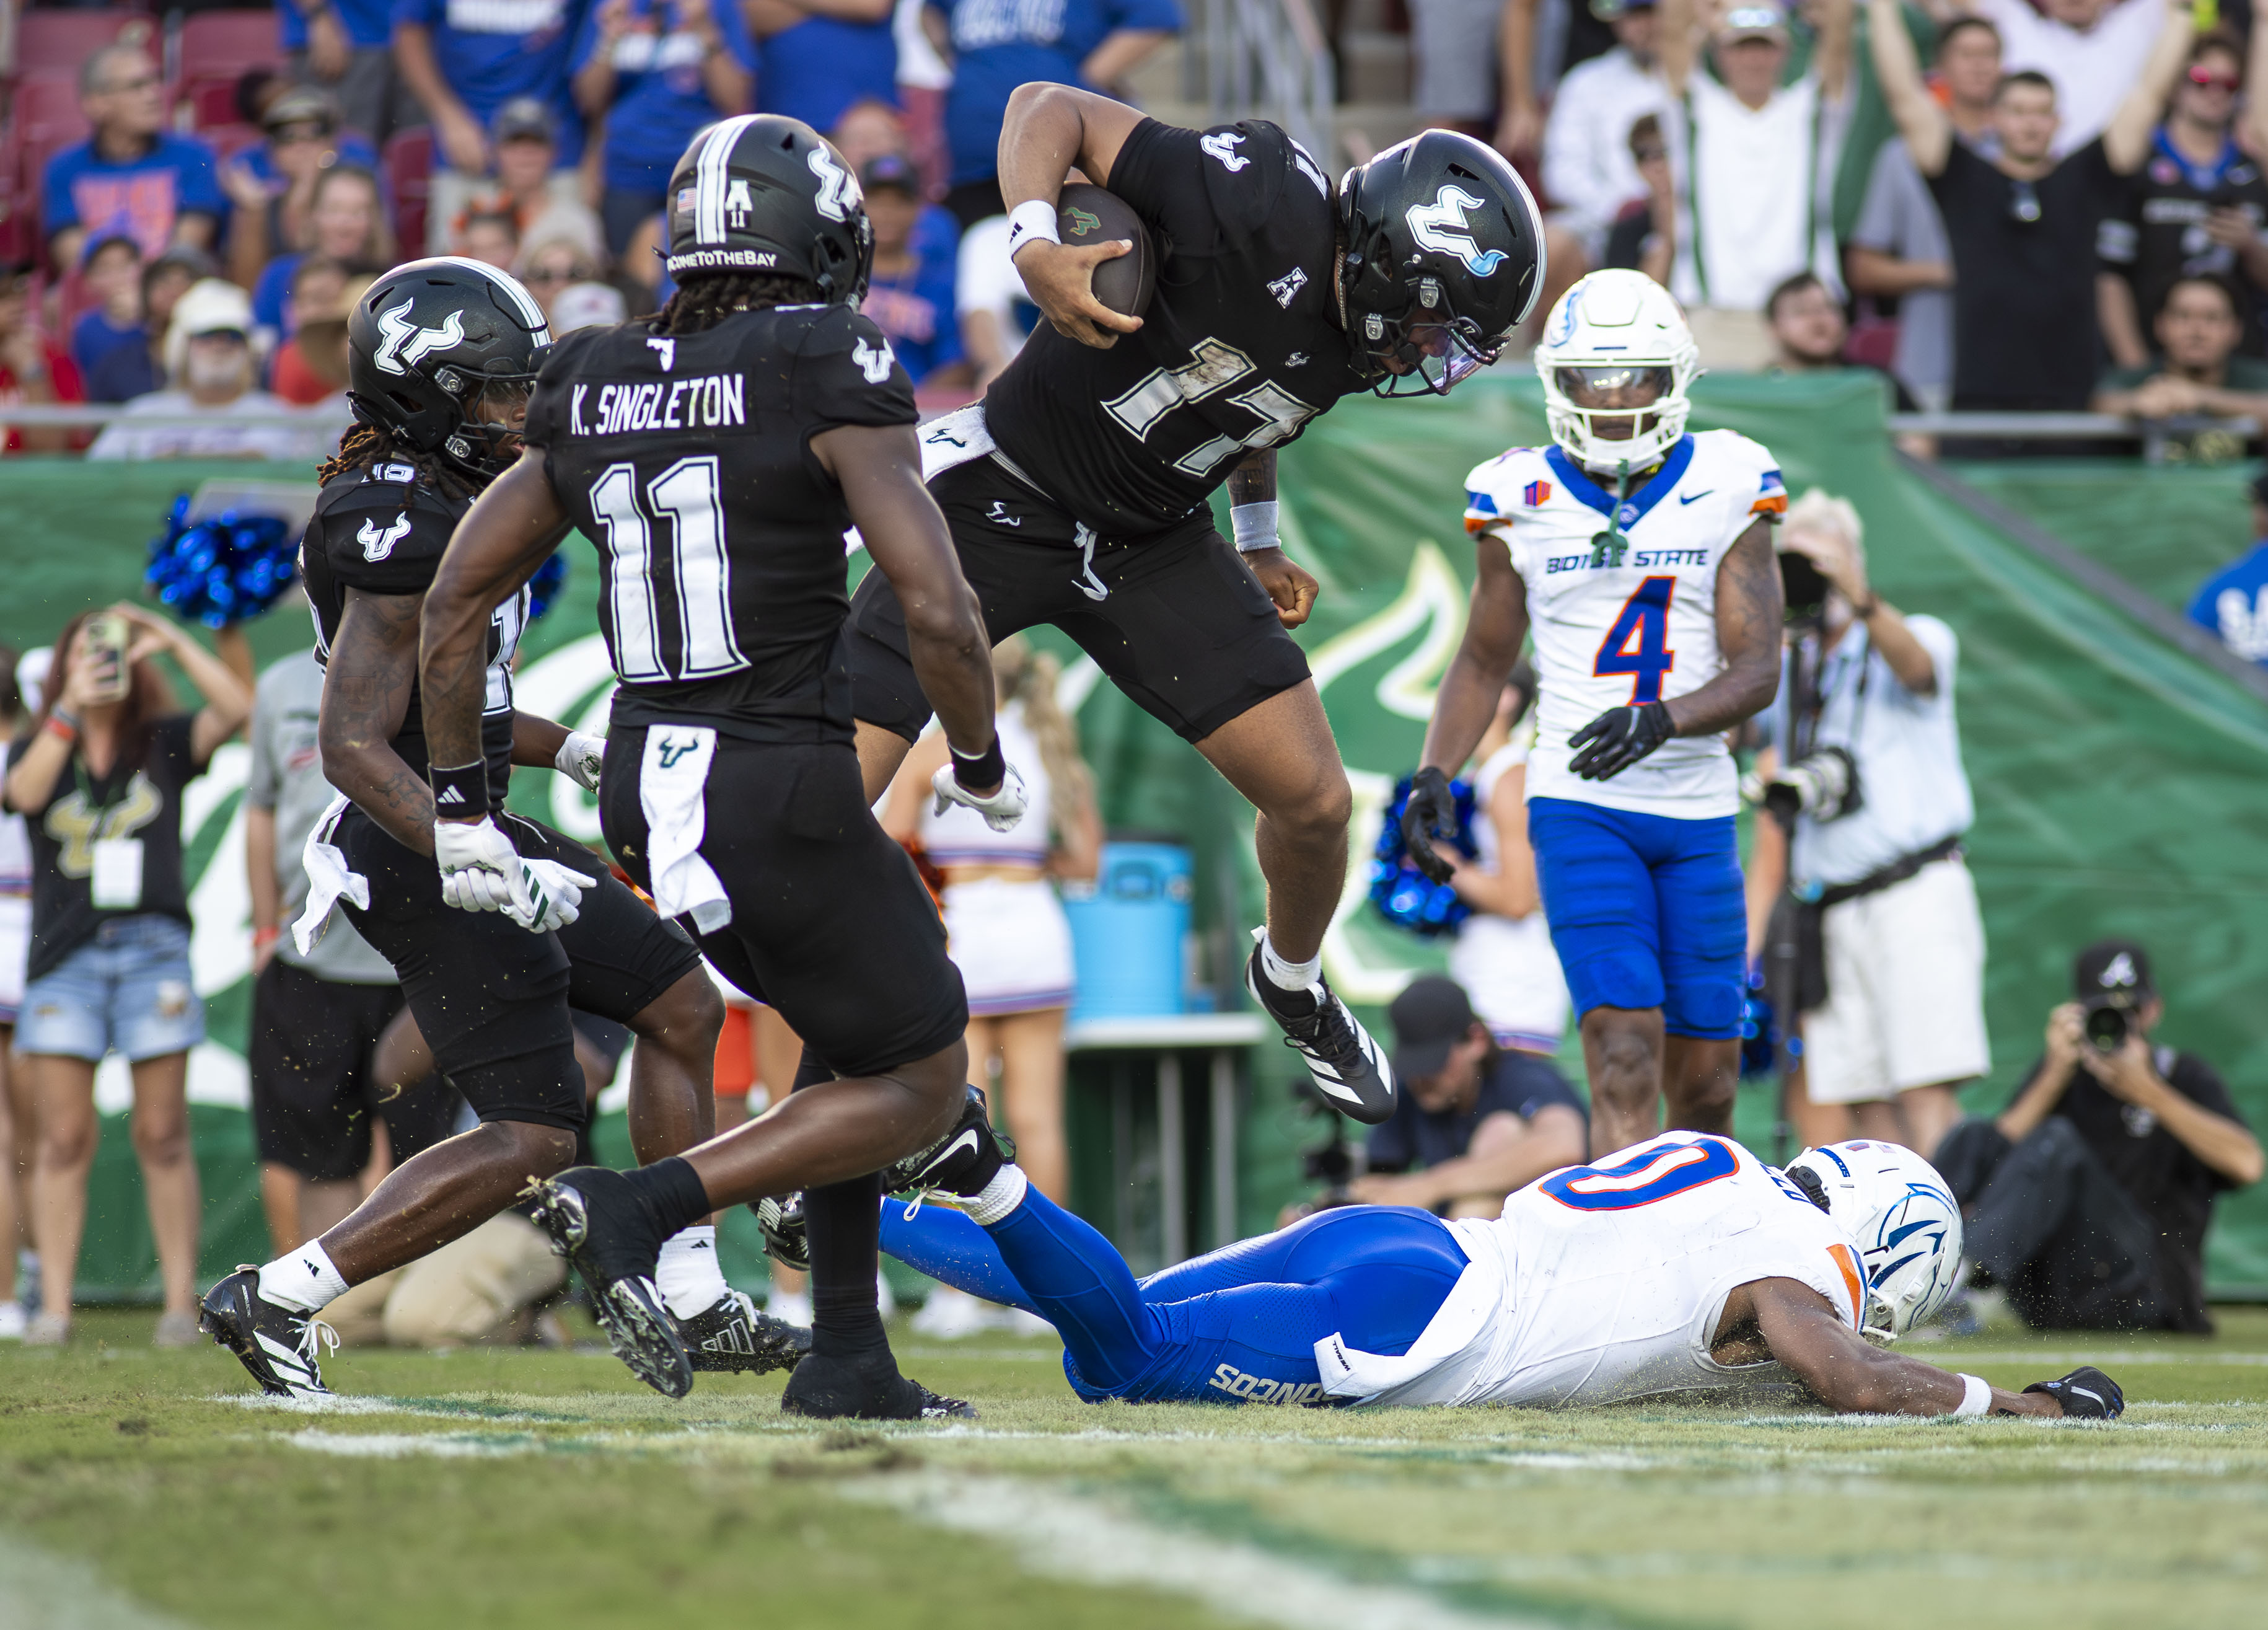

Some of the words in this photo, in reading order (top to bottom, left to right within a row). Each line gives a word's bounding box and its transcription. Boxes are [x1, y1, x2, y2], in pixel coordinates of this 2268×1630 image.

[731, 211, 745, 228] 11
[1464, 325, 1475, 334] 17
[571, 384, 589, 435] K.
[596, 373, 745, 434] SINGLETON
[1100, 337, 1321, 477] 17
[589, 455, 752, 684] 11
[1546, 548, 1625, 574] BOI
[1633, 550, 1708, 568] STATE
[1593, 575, 1677, 706] 4
[1538, 1138, 1739, 1212] 0
[1209, 1363, 1343, 1403] ONCOS
